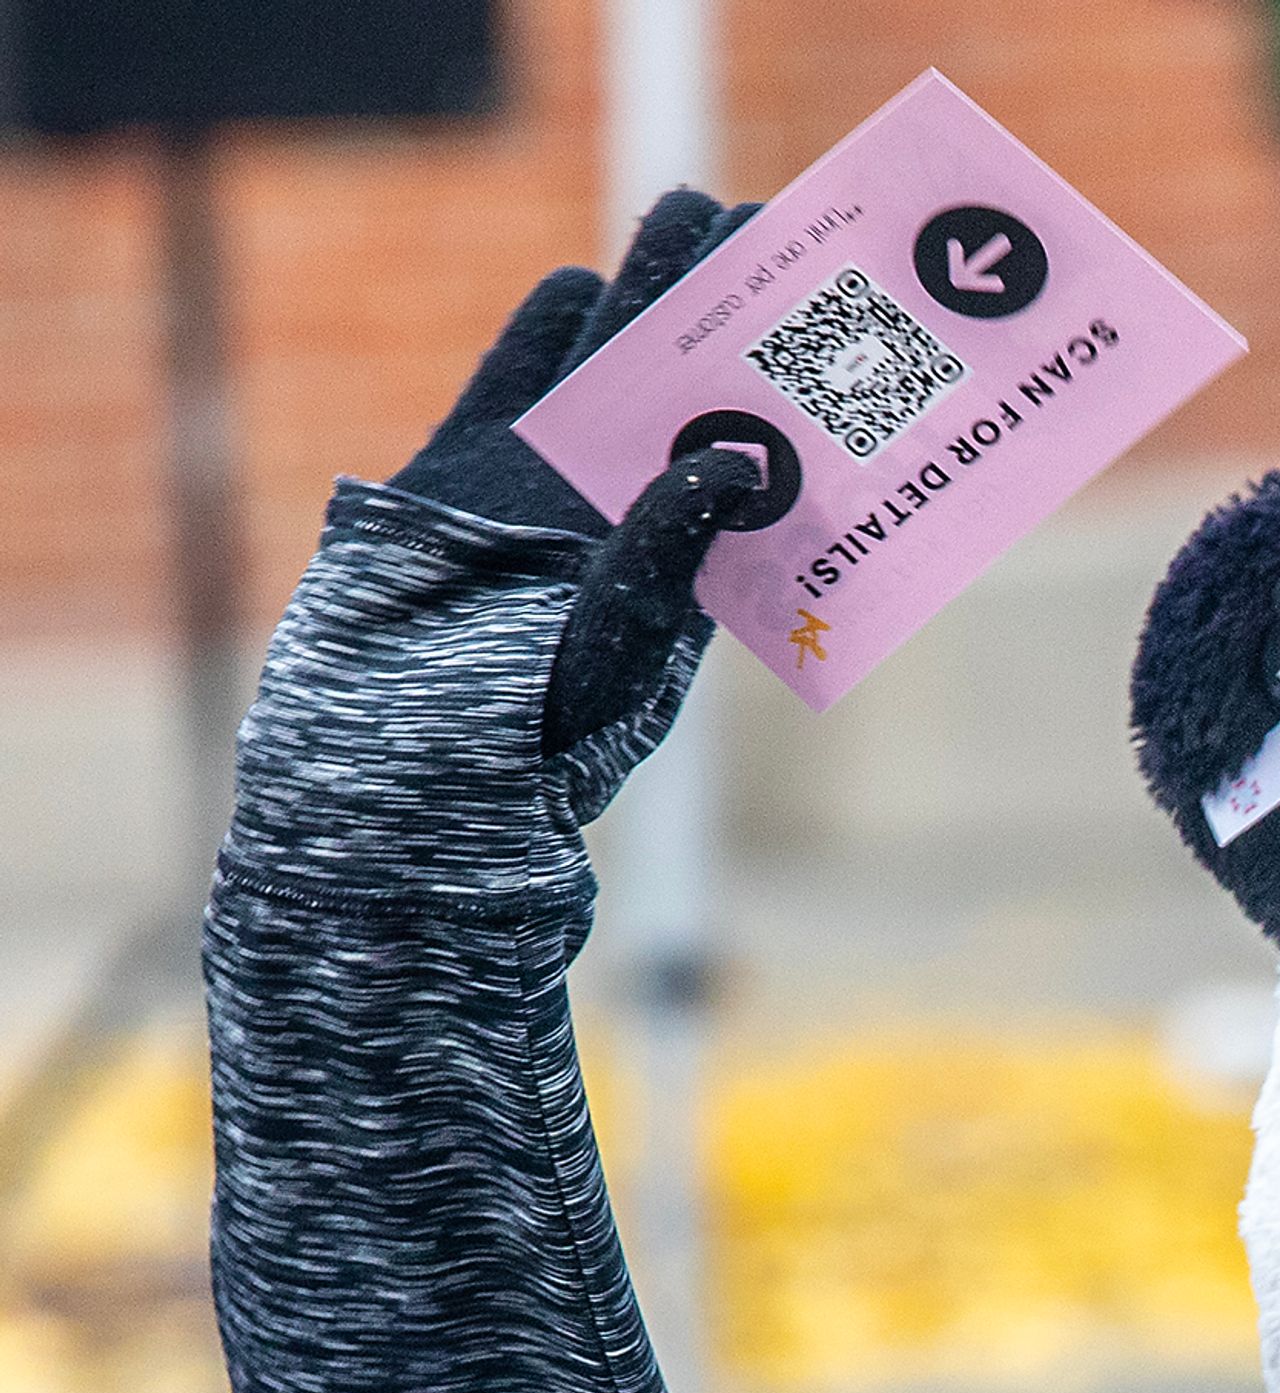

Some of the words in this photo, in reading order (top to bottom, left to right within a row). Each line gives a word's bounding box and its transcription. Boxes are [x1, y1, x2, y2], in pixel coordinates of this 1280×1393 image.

[743, 263, 776, 295] per
[770, 239, 807, 271] one
[674, 294, 743, 355] customer
[1017, 318, 1120, 409] SCAN
[943, 400, 1024, 467] FOR
[794, 460, 953, 600] DETAILS!
